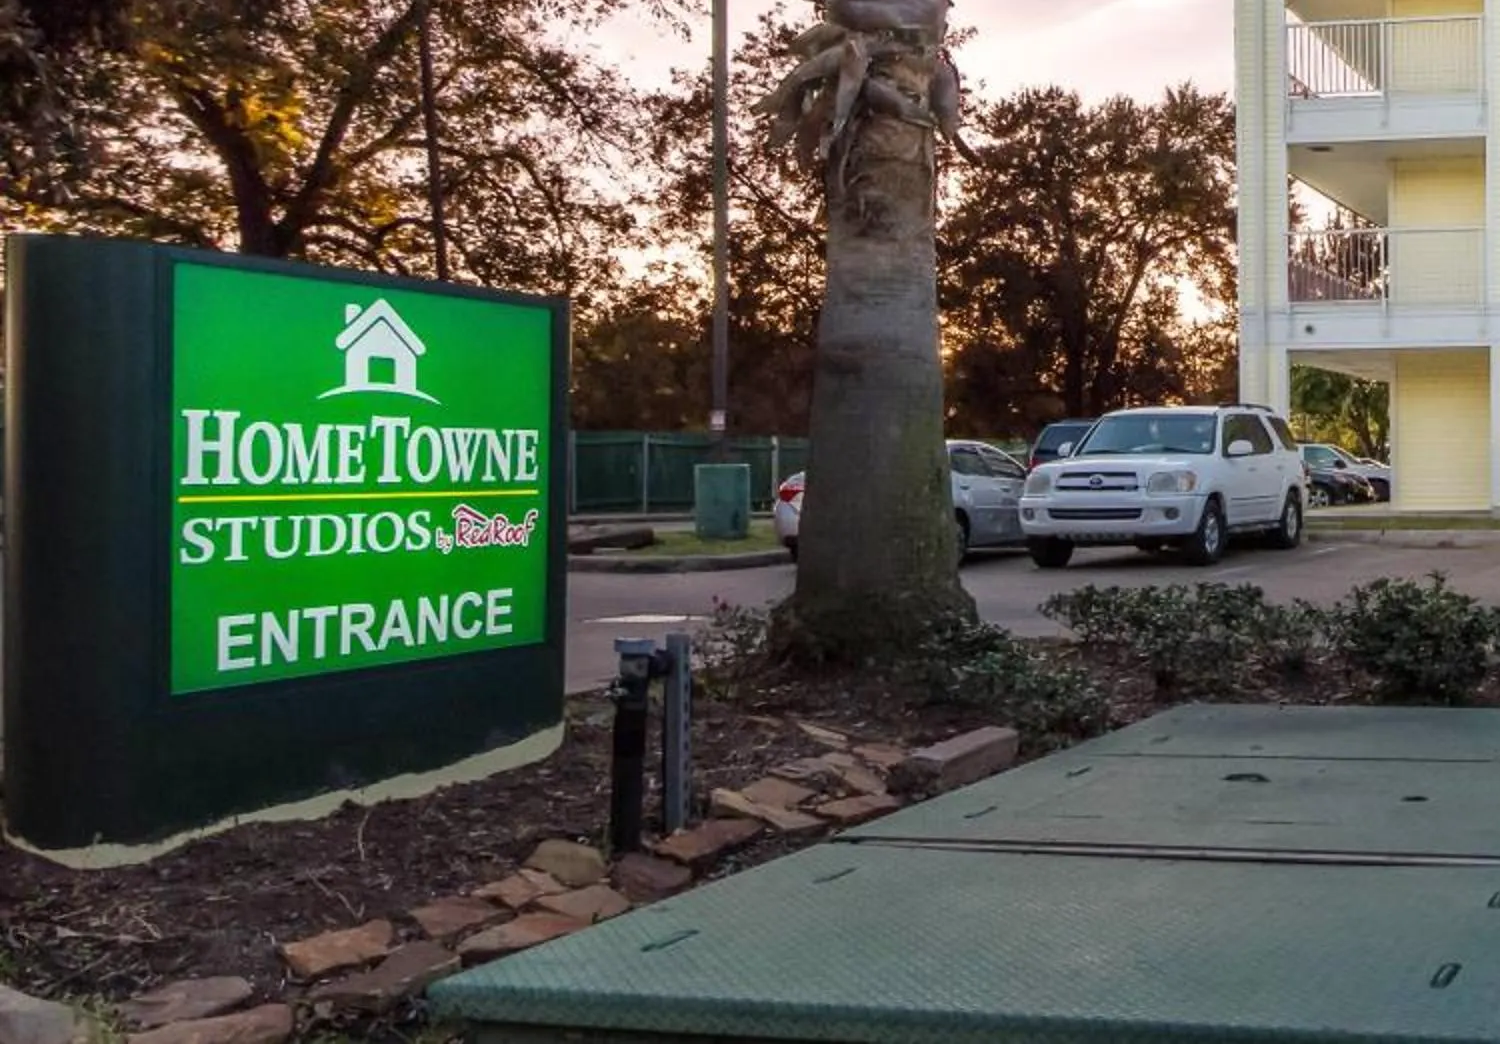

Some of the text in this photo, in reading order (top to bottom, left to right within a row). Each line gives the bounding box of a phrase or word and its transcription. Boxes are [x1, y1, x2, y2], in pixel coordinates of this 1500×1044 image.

[180, 511, 432, 564] STUDIOS
[435, 526, 454, 554] by
[216, 587, 513, 672] ENTRANCE
